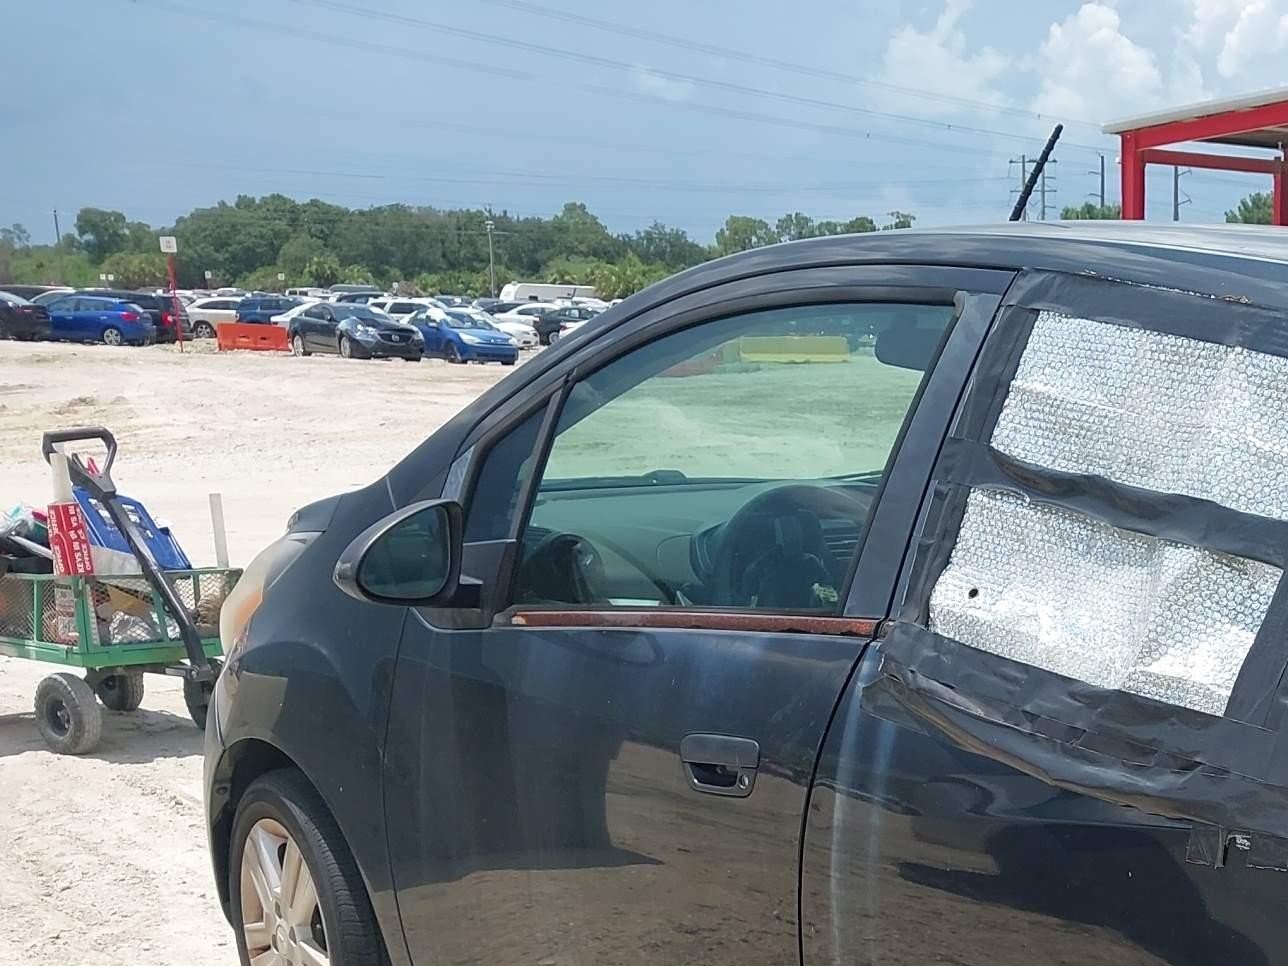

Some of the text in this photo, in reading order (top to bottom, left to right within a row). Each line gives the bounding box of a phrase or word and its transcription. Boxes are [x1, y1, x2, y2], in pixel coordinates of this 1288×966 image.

[54, 544, 65, 573] OFFICE
[72, 541, 85, 573] KEYS IN
[81, 543, 91, 571] OFFICE
